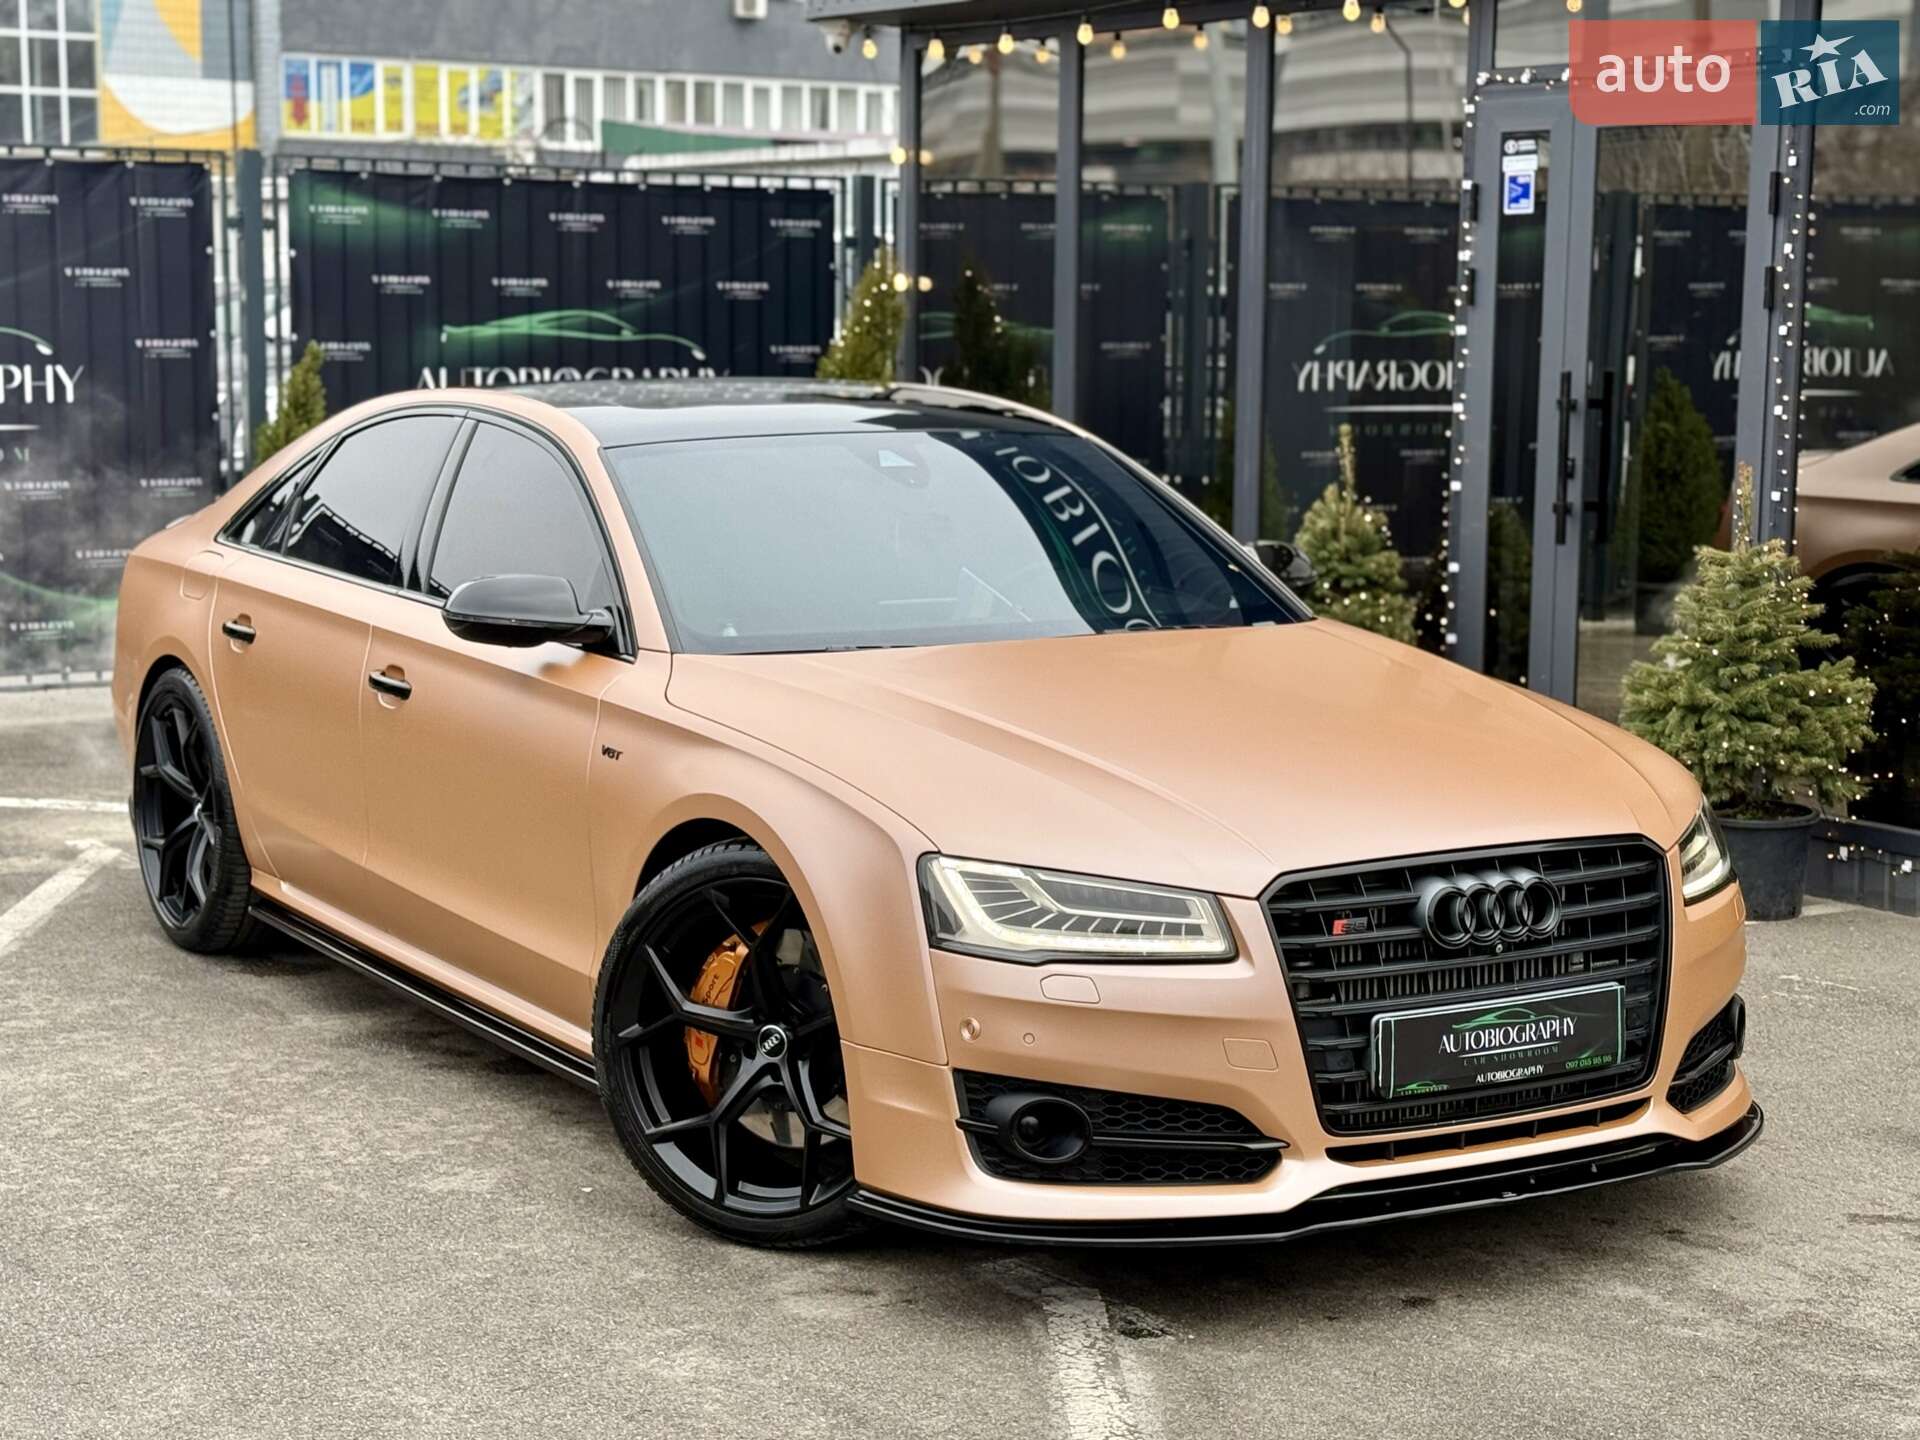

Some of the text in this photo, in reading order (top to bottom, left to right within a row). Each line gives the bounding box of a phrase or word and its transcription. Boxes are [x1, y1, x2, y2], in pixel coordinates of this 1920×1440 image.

[1438, 1016, 1578, 1055] AUTOBIOGRAPHY
[1463, 1045, 1560, 1067] CAR SHOWROOM
[1475, 1064, 1545, 1084] AUTOBIOGRAPHY
